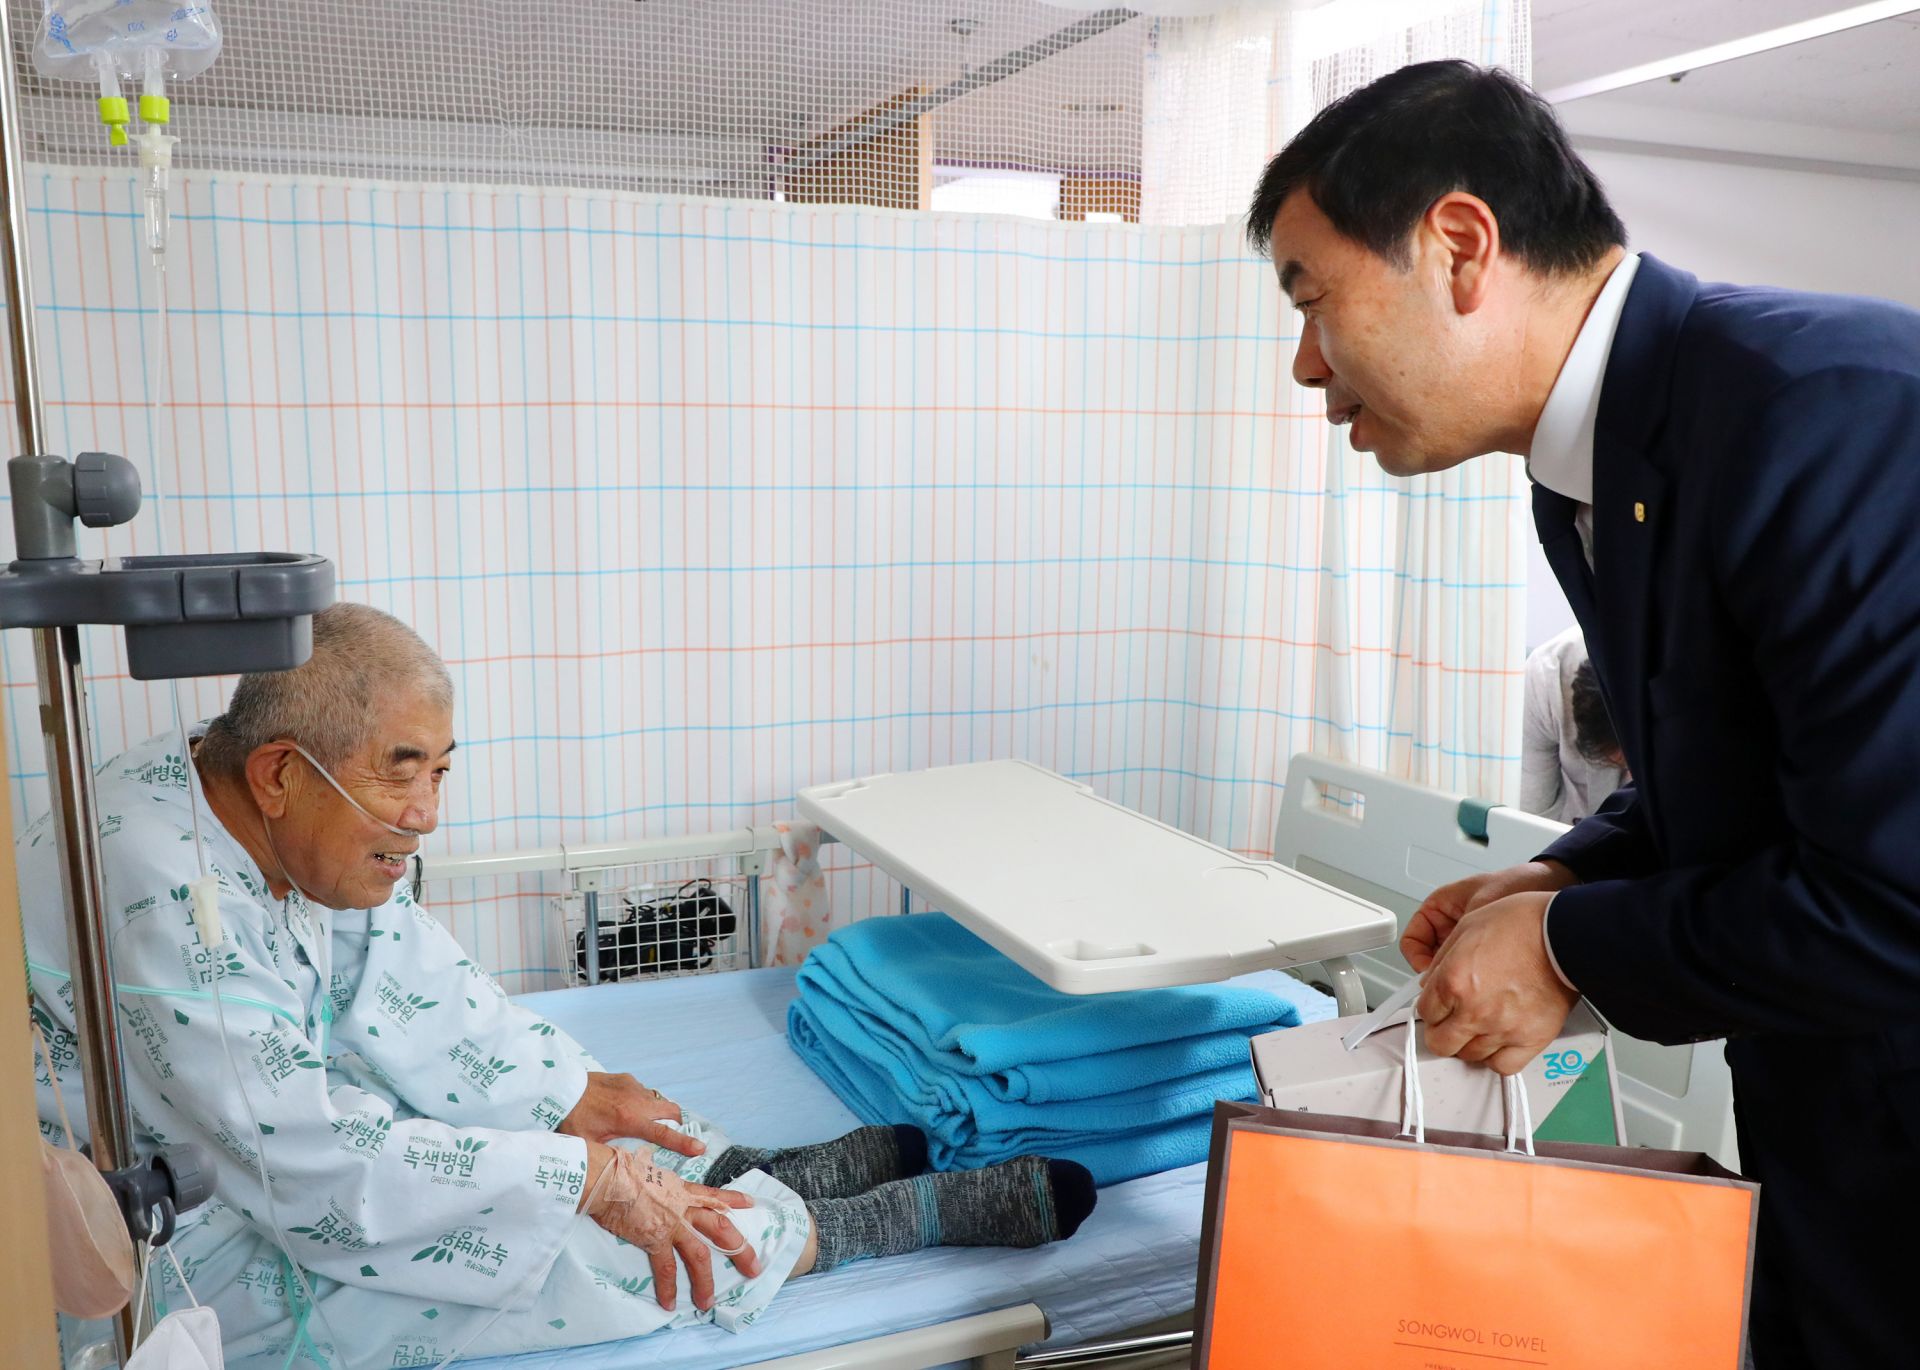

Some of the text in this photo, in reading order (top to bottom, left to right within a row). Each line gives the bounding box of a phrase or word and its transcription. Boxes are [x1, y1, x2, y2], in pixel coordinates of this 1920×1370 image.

[447, 1044, 500, 1089] 녹색병원
[1543, 1050, 1583, 1080] 30
[403, 1145, 476, 1178] 녹색병원
[430, 1175, 482, 1191] GREEN HOSPITAL
[435, 1230, 509, 1267] 녹색병원
[1397, 1319, 1548, 1353] SONGWOL TOWEL
